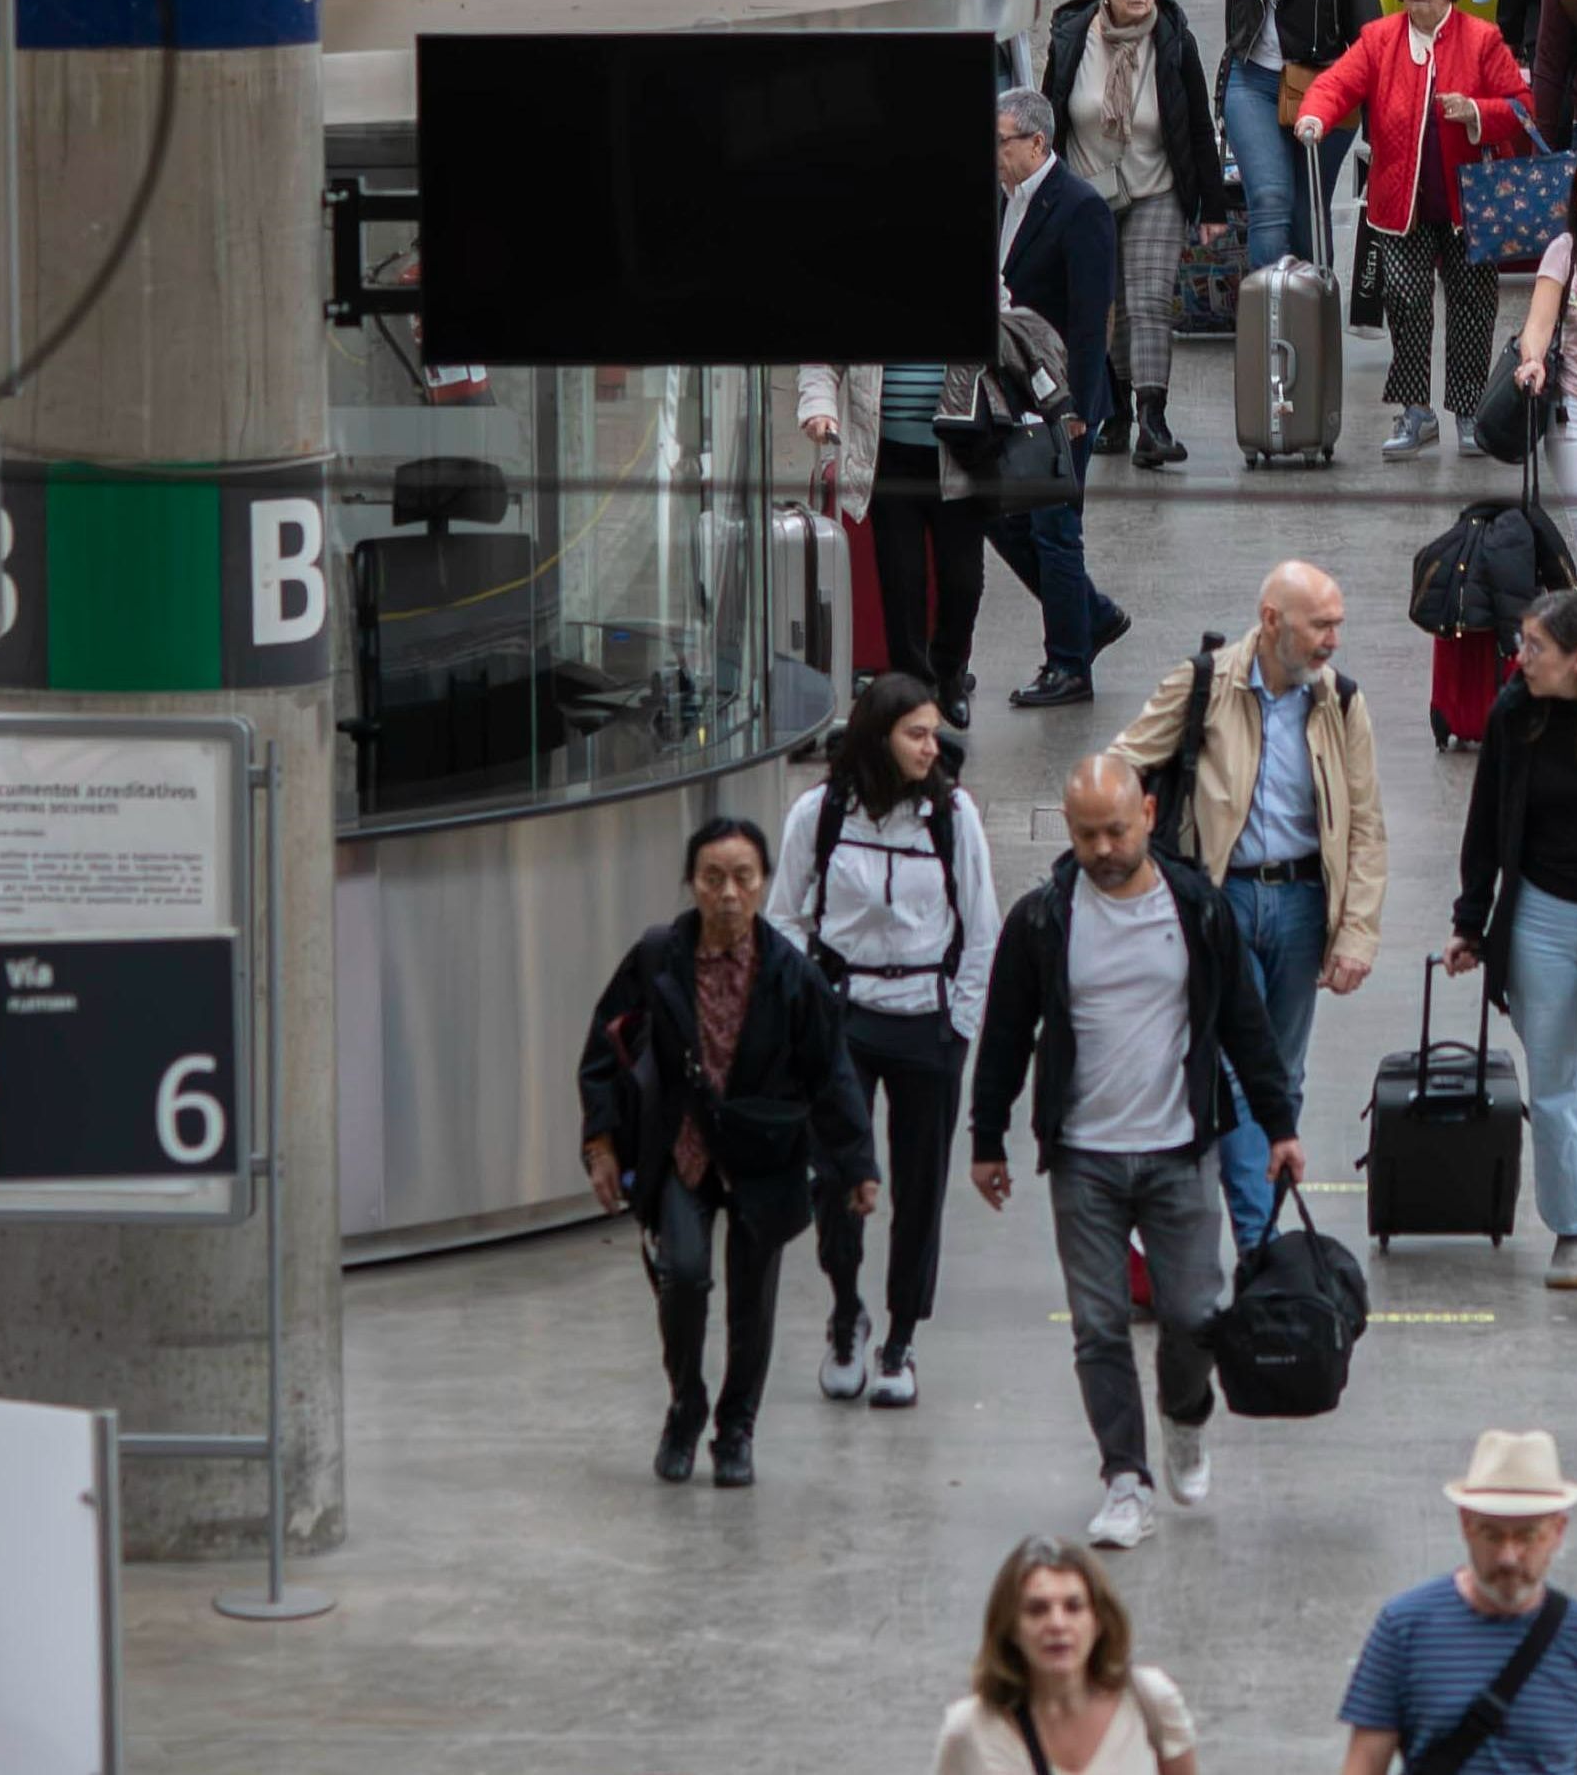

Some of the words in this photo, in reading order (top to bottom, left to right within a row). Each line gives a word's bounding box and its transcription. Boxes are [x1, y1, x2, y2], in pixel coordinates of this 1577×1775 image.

[249, 497, 327, 646] B
[86, 781, 198, 801] acreditativos
[5, 956, 54, 990] Vía
[153, 1054, 227, 1164] 6
